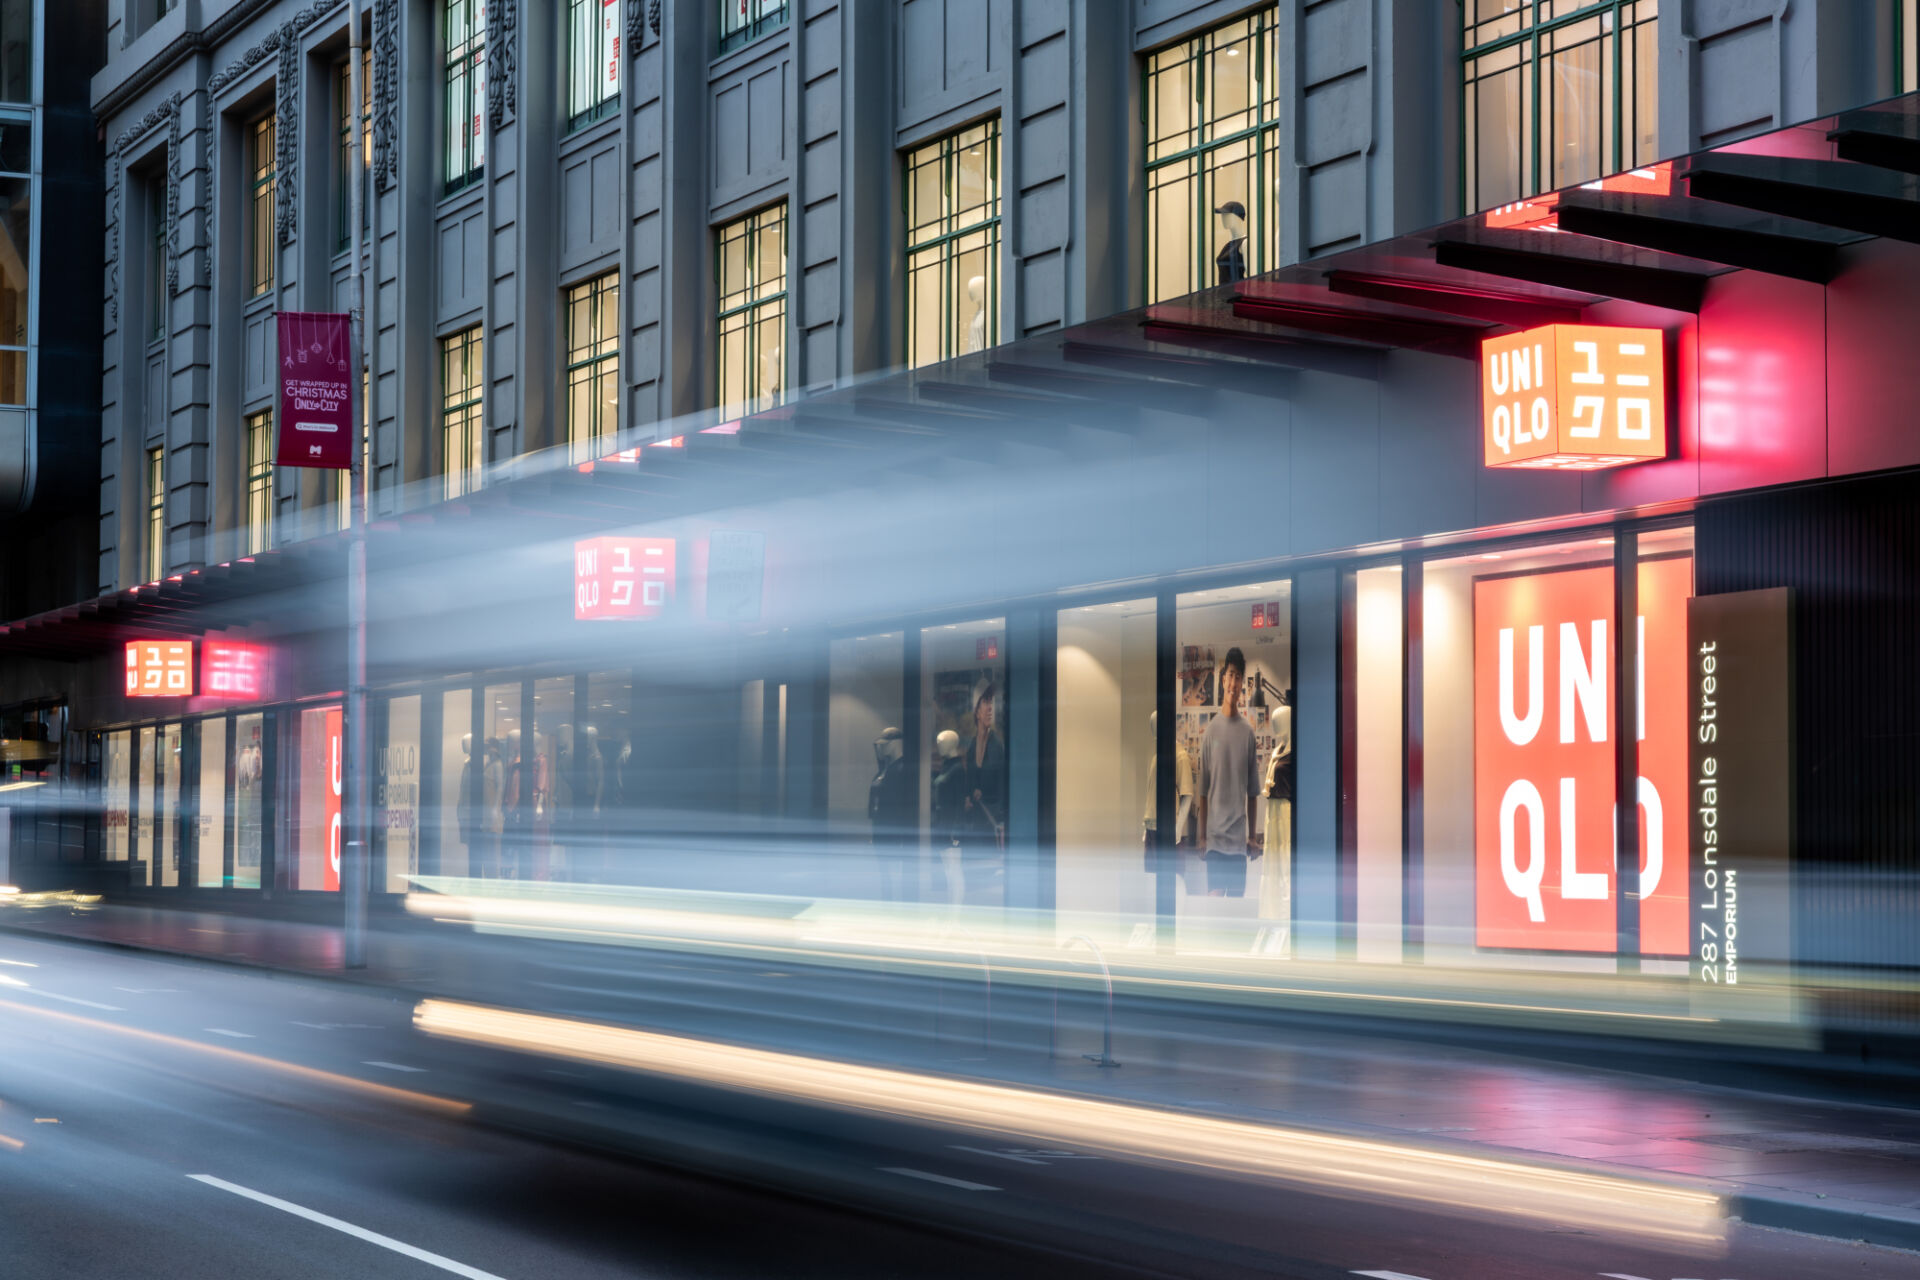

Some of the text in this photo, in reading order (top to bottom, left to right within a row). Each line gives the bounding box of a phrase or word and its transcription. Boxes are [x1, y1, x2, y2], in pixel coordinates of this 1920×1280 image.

[1491, 344, 1543, 395] UNI
[1571, 341, 1650, 387] ユニ
[286, 387, 348, 400] CHRISTMAS
[1493, 397, 1549, 454] QLO
[1569, 396, 1651, 440] クロ
[577, 548, 598, 577] UNI
[612, 547, 665, 573] ユニ
[578, 580, 599, 613] QLO
[610, 580, 665, 606] クロ
[145, 648, 185, 666] ユニ
[144, 670, 185, 689] クロ
[1499, 616, 1645, 746] UNI
[1699, 641, 1718, 984] 287 Lonsdale Street
[1499, 776, 1663, 922] QLO
[1725, 870, 1737, 984] EMPORIUM
